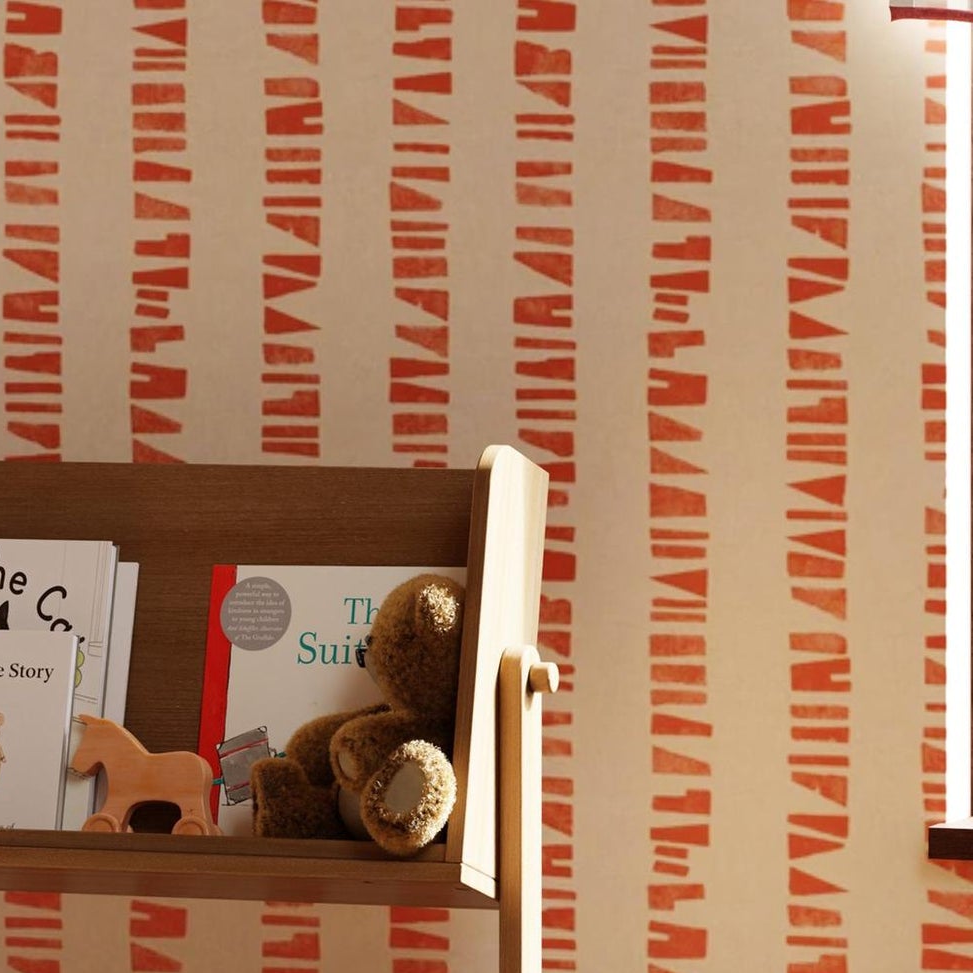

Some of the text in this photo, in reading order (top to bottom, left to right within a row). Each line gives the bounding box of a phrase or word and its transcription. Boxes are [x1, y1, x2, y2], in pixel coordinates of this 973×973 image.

[36, 575, 85, 643] Ca
[344, 597, 379, 624] Th
[297, 632, 366, 665] Suit
[9, 663, 54, 683] Story
